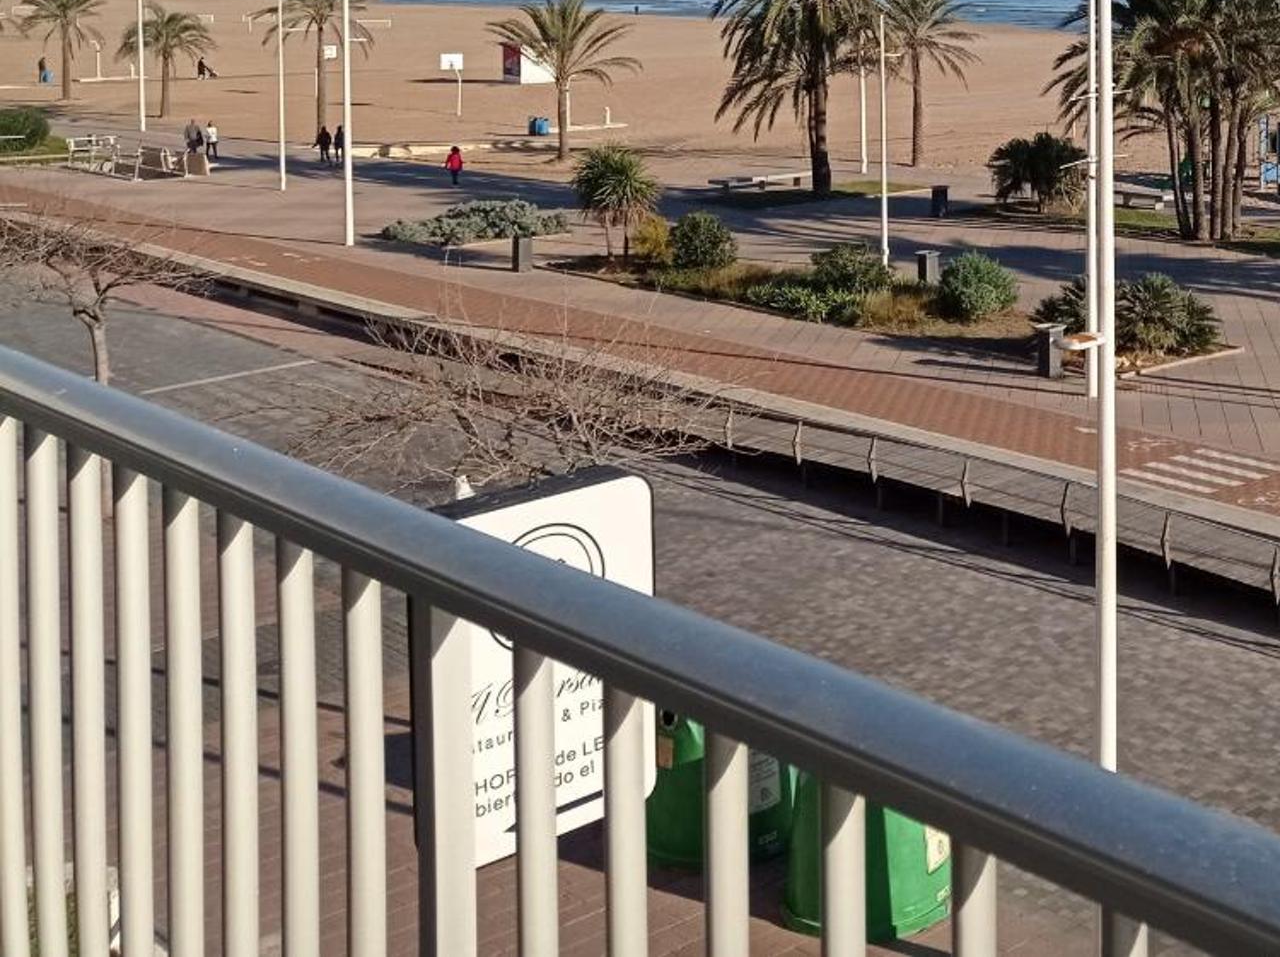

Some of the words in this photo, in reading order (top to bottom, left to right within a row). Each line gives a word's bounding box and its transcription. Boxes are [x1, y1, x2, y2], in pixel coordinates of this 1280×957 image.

[561, 707, 571, 722] &
[555, 749, 576, 766] de
[582, 736, 603, 756] LE
[475, 793, 514, 818] bier
[579, 759, 595, 777] el
